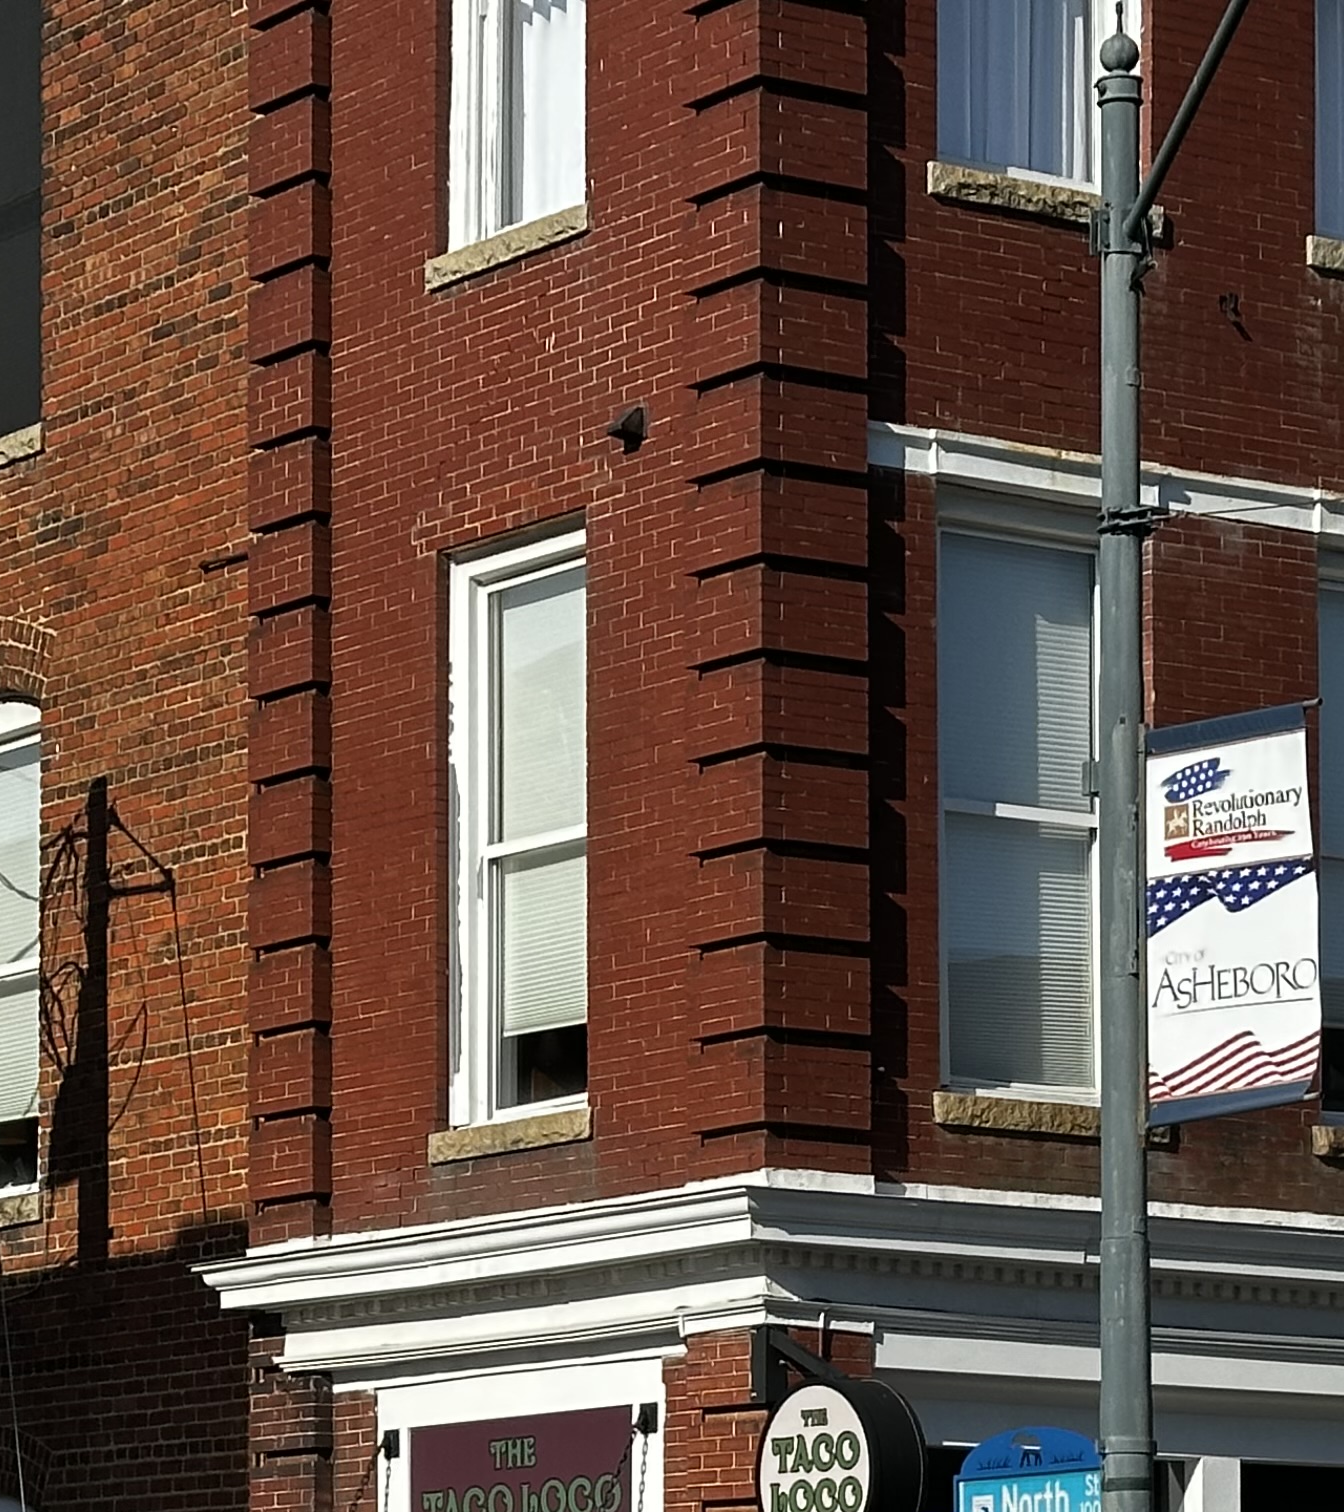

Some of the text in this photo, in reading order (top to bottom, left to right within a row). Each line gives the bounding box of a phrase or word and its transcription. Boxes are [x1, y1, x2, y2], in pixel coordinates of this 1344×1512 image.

[1192, 786, 1302, 818] Revolutionary
[1192, 809, 1267, 837] Randolph
[800, 1407, 829, 1428] THE
[489, 1436, 537, 1471] THE
[771, 1430, 861, 1474] TACO
[1084, 1473, 1101, 1497] St
